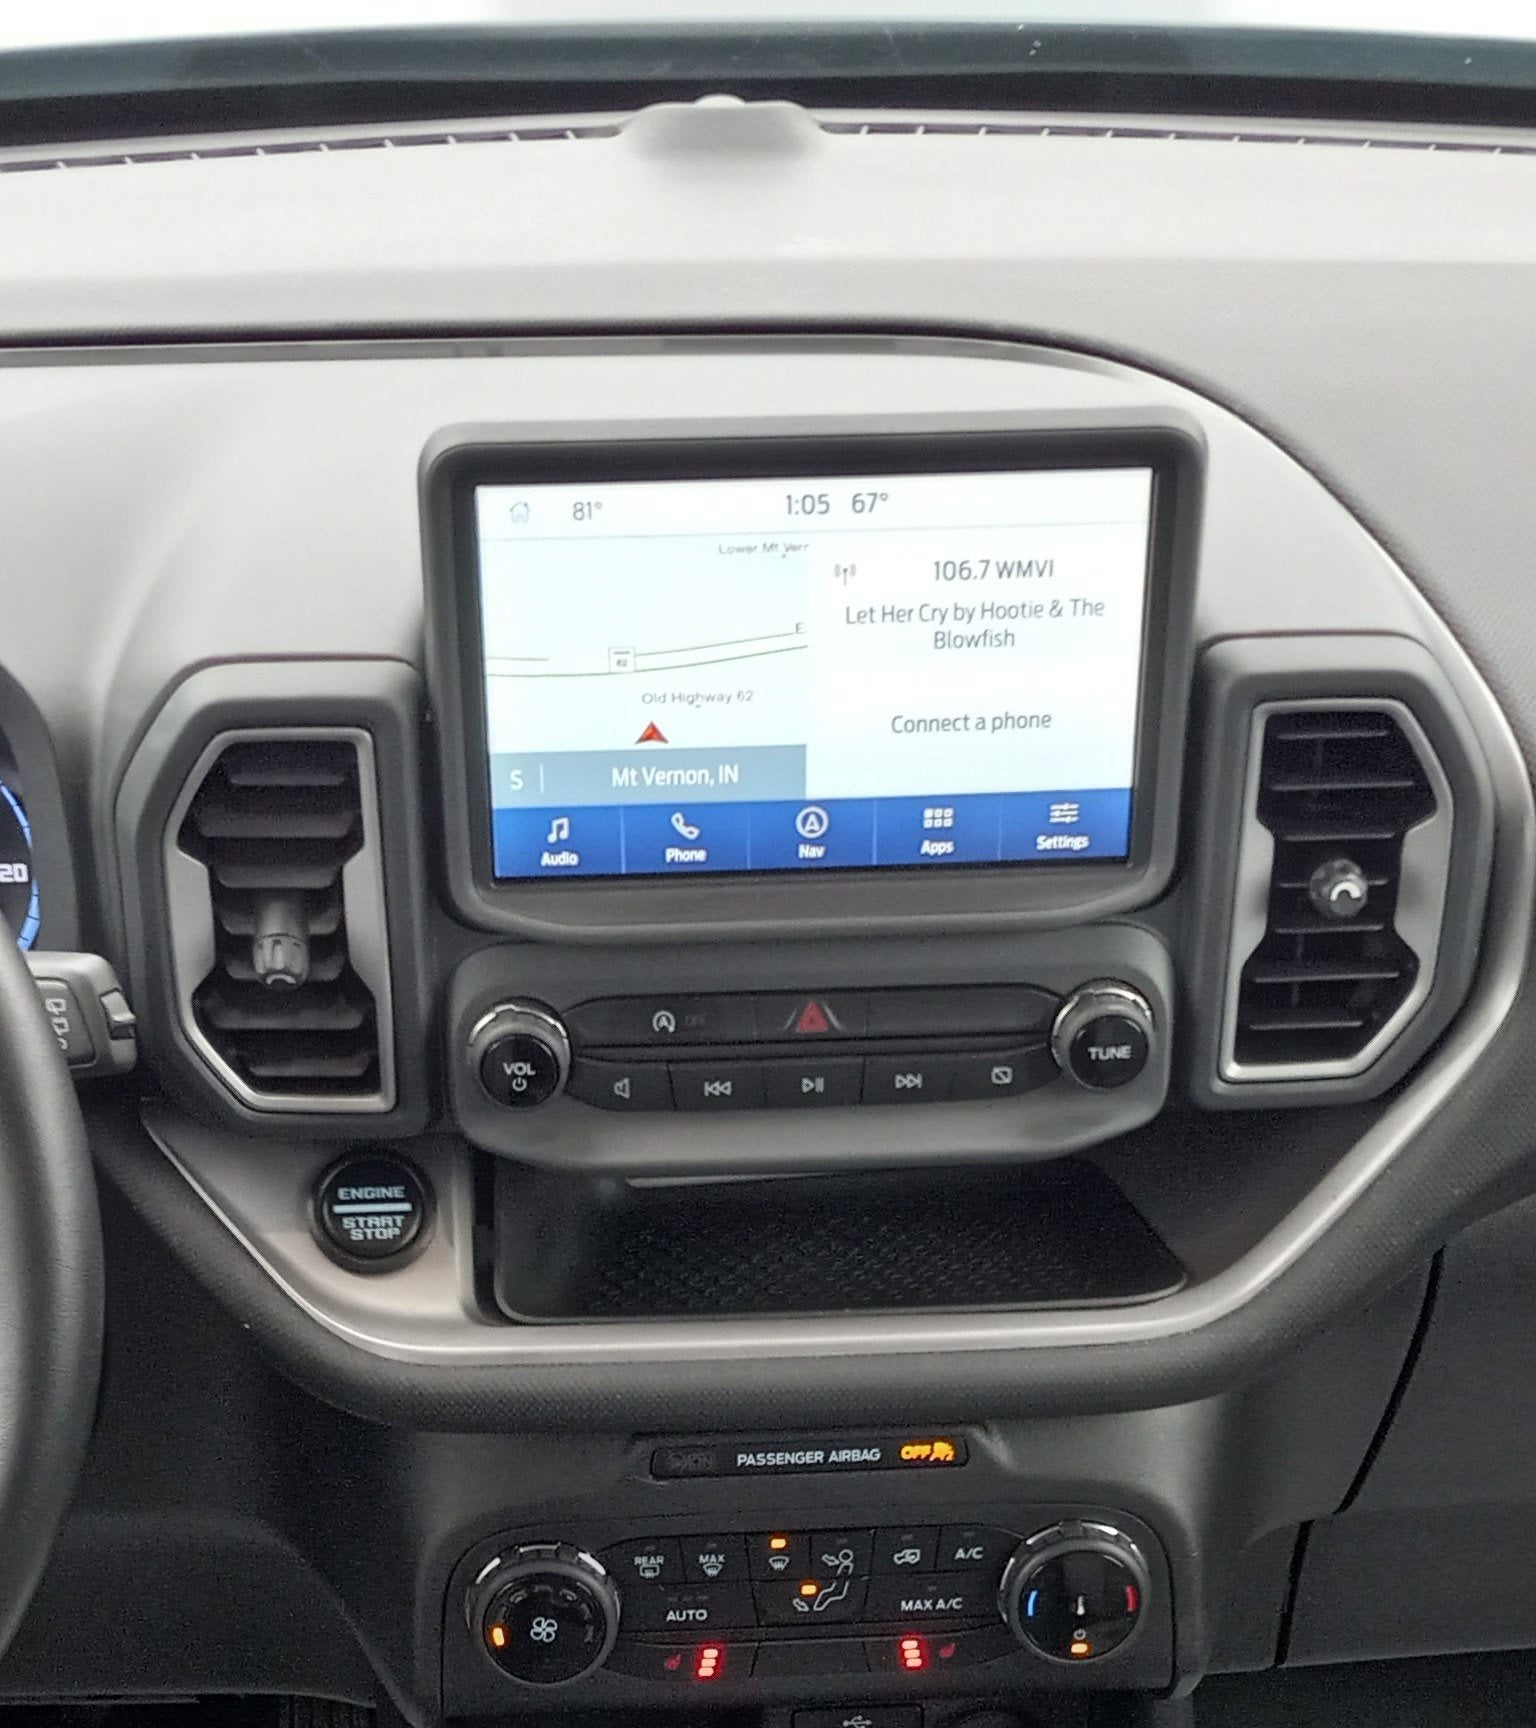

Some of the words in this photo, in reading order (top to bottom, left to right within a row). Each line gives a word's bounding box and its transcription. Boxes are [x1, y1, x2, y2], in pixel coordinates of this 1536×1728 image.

[572, 501, 603, 522] 81°
[785, 493, 830, 516] 1:05
[851, 492, 889, 514] 67°
[933, 559, 991, 582] 106.7
[995, 559, 1055, 579] WMVI
[845, 605, 876, 625] Let
[881, 604, 915, 623] Her
[918, 603, 949, 626] Cry
[953, 602, 976, 625] by
[980, 600, 1044, 621] Hootie
[1049, 599, 1064, 619] &
[1070, 597, 1106, 617] The
[933, 628, 1016, 650] Blowfish
[641, 692, 667, 705] Old
[671, 691, 732, 706] Highway
[737, 690, 754, 702] 62
[891, 713, 971, 734] Connect
[975, 717, 986, 731] a
[991, 711, 1053, 734] phone
[510, 769, 524, 791] S
[612, 765, 638, 788] Mt
[641, 764, 715, 788] Vernon,
[719, 763, 740, 784] IN
[920, 839, 956, 857] Apps
[1036, 834, 1091, 852] Settings
[540, 851, 580, 867] Audio
[665, 847, 708, 863] Phone
[798, 843, 826, 860] Nav
[1087, 1045, 1132, 1061] TUNE
[503, 1061, 536, 1076] VOL
[337, 1186, 406, 1200] ENGINE
[342, 1215, 405, 1229] START
[350, 1227, 401, 1241] STOP
[737, 1450, 824, 1467] PASSENGER
[828, 1448, 881, 1463] AIRBAG
[901, 1445, 932, 1460] OFF
[634, 1556, 664, 1566] REAR
[699, 1554, 725, 1563] MAX
[955, 1547, 984, 1560] A/C
[901, 1599, 933, 1611] MAX
[935, 1598, 963, 1611] A/C
[666, 1609, 708, 1622] AUTO
